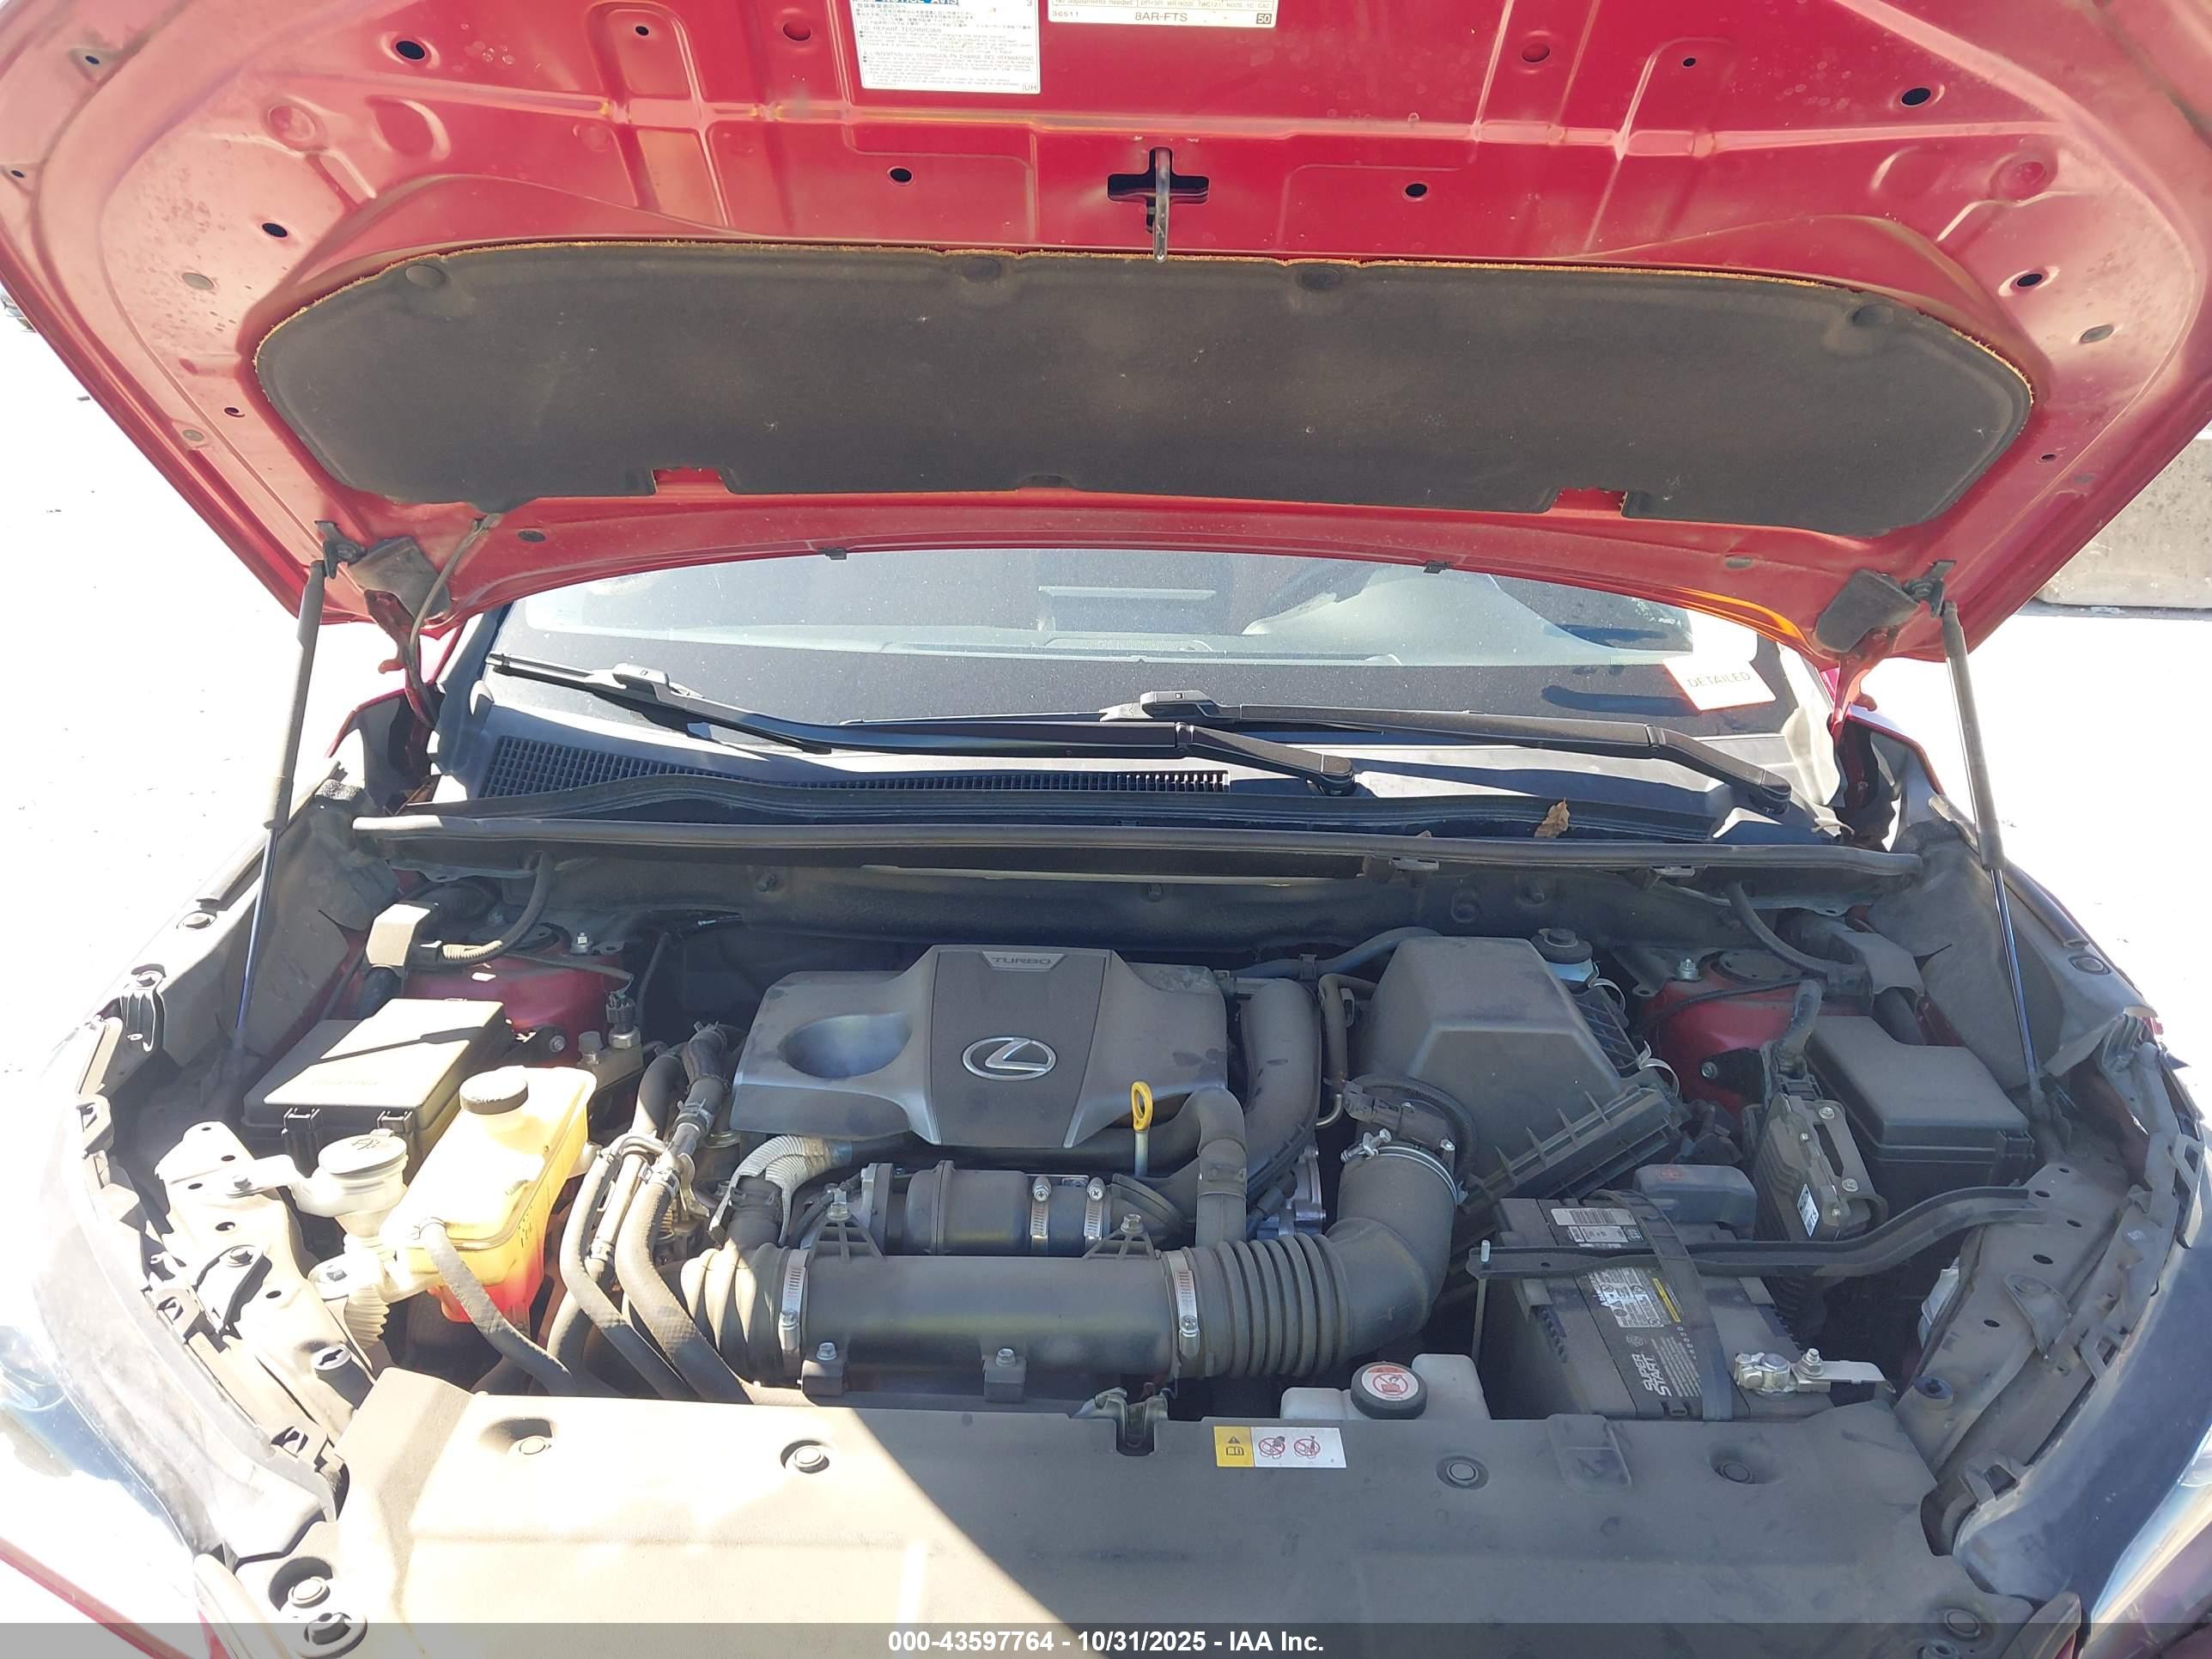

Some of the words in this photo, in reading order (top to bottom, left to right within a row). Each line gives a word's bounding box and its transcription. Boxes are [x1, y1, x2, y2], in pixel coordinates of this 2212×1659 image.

[1257, 14, 1271, 24] 50
[1686, 672, 1751, 688] DETAILED
[1632, 1353, 1658, 1392] SUPER
[1641, 1353, 1673, 1397] START
